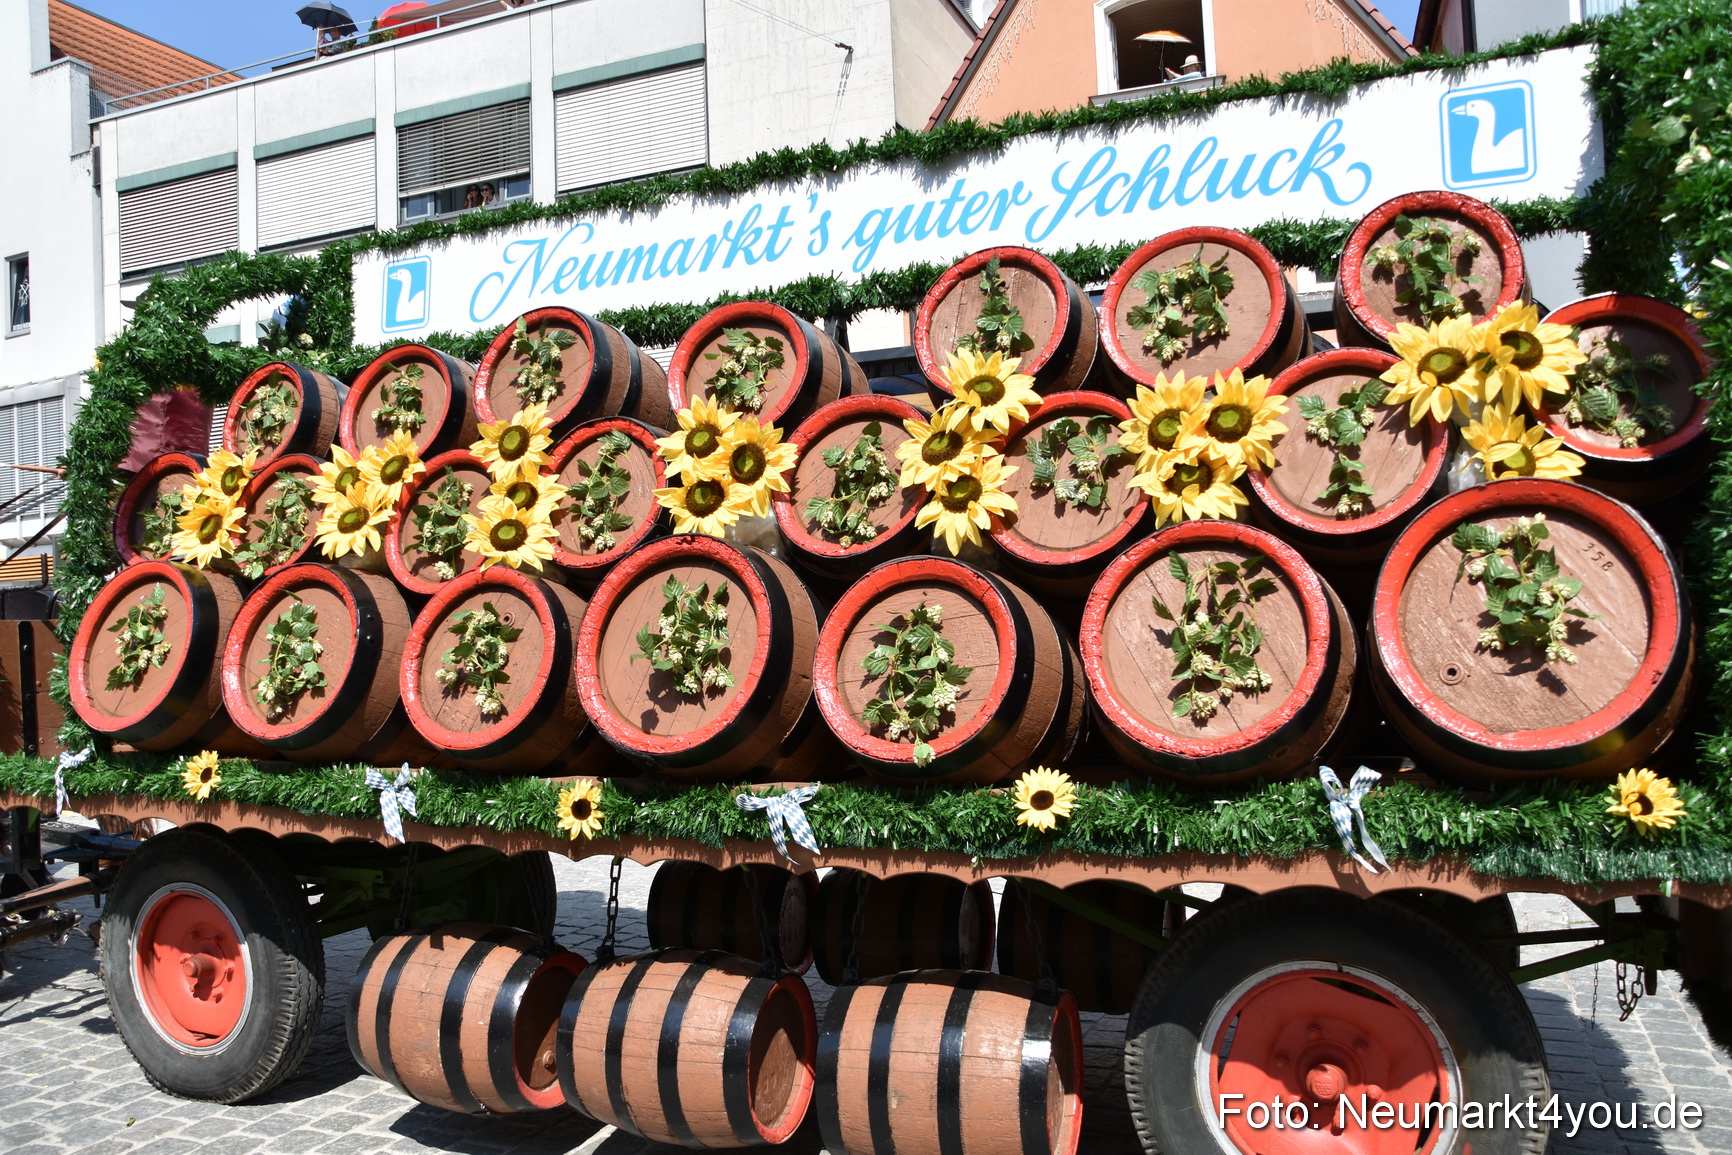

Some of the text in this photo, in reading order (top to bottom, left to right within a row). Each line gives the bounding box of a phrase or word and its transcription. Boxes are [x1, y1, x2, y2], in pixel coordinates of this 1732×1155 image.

[468, 117, 1374, 325] Neumarkt's guter Schluck
